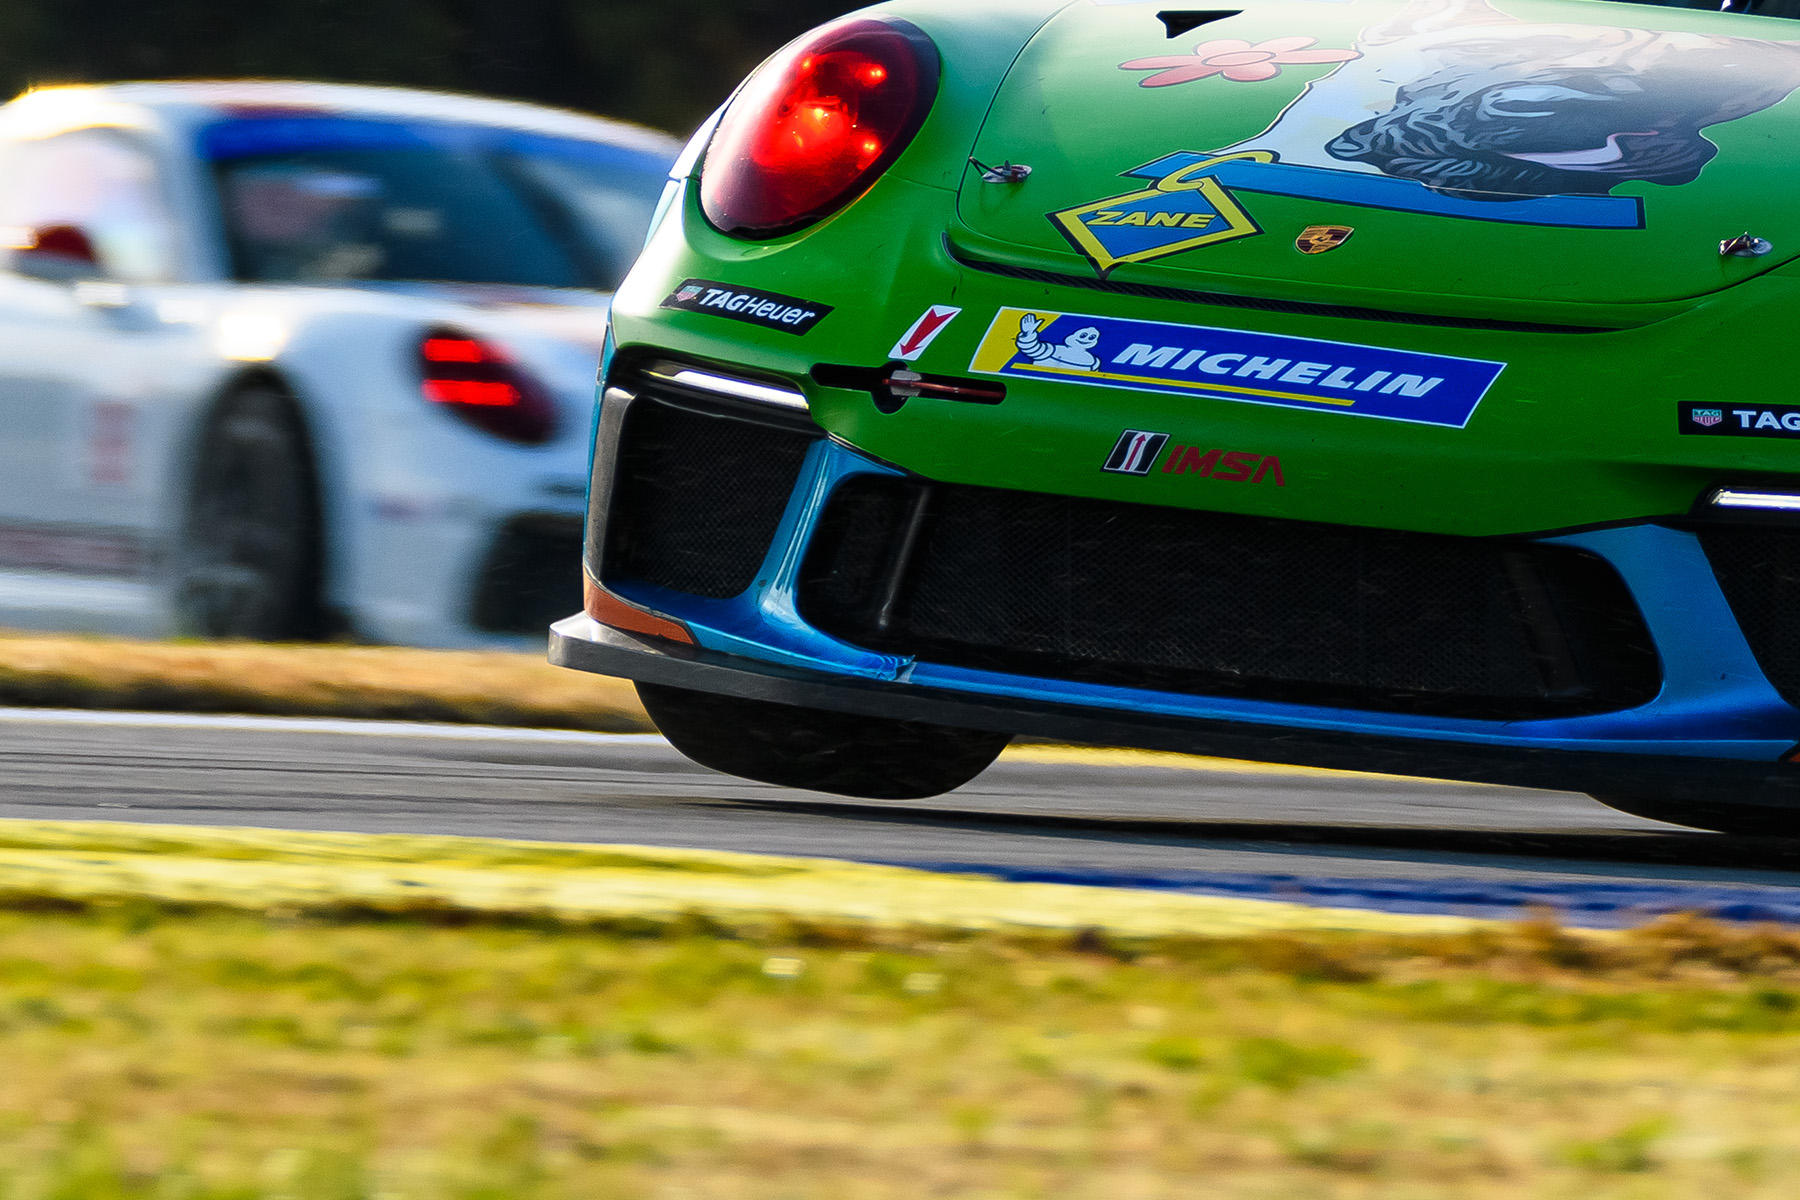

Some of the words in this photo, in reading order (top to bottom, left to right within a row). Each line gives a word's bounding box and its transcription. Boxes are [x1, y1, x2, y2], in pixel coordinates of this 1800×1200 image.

[1086, 210, 1217, 229] ZANE
[1111, 342, 1444, 398] MICHELIN
[1160, 444, 1286, 487] IMSA
